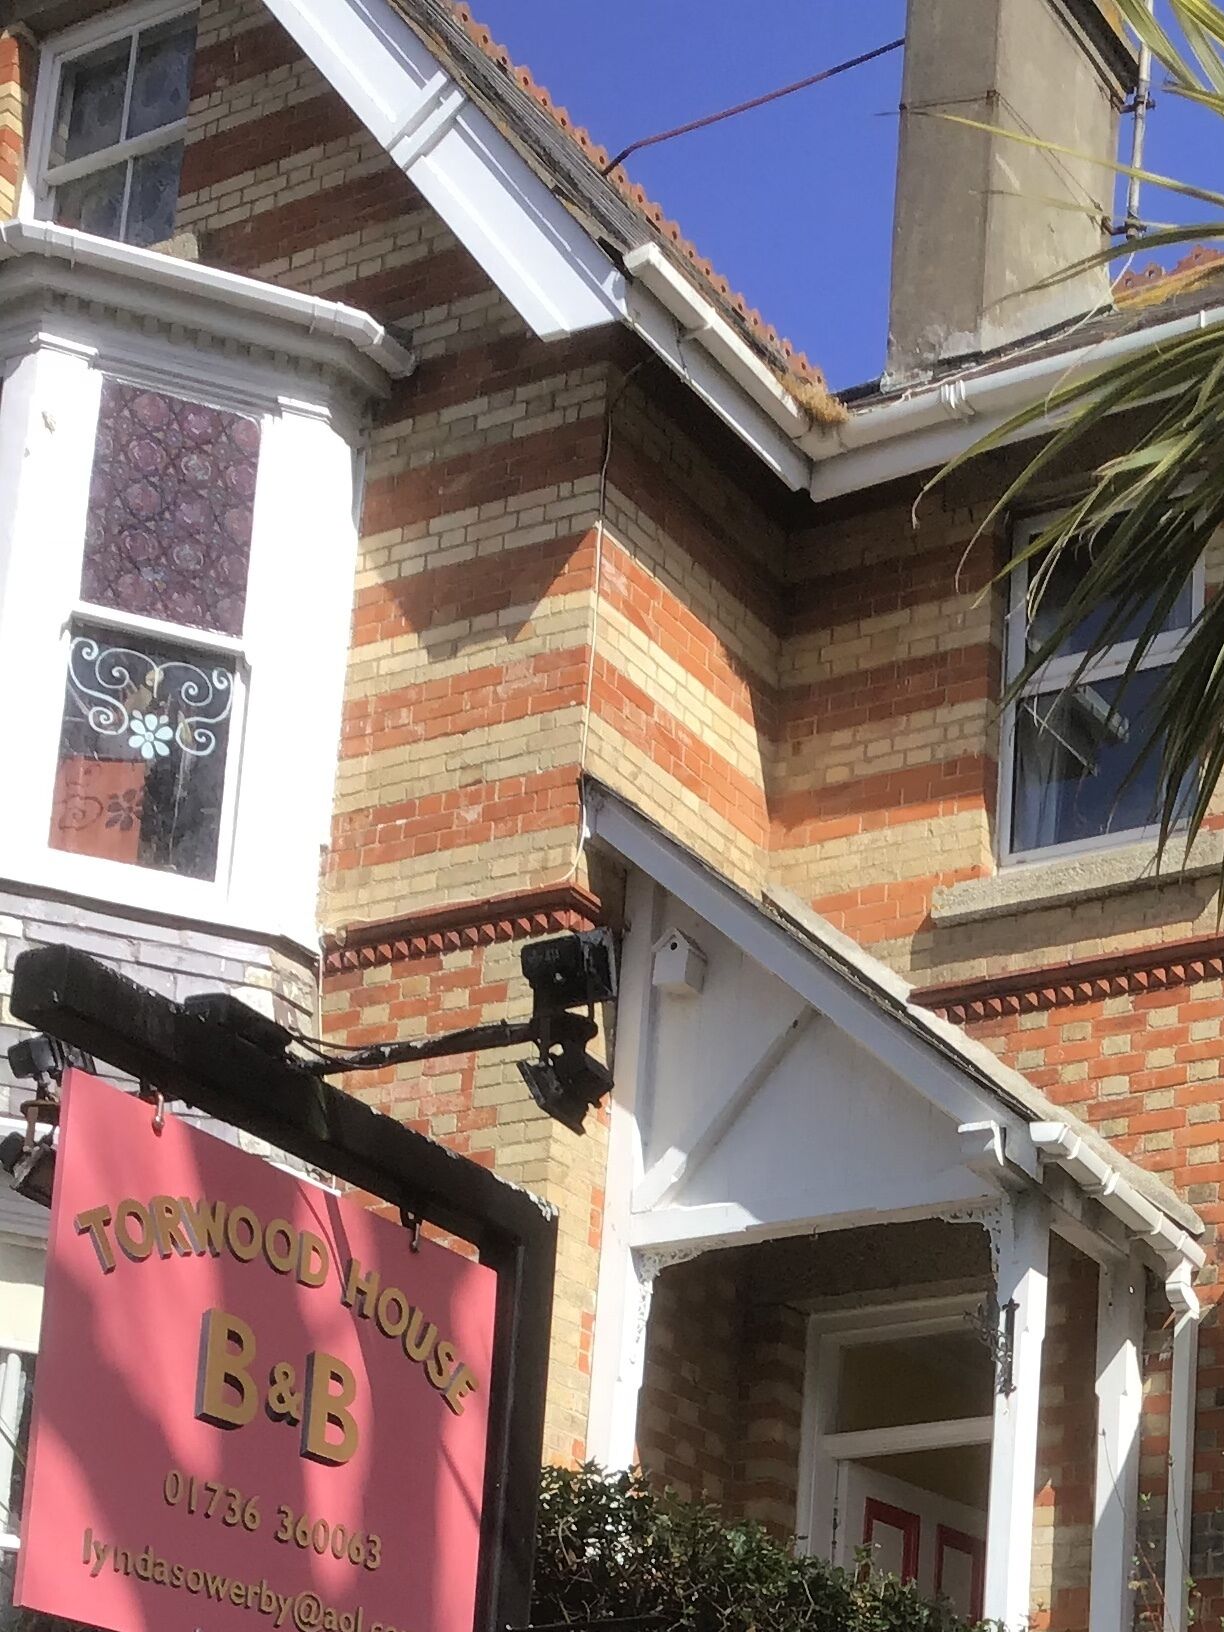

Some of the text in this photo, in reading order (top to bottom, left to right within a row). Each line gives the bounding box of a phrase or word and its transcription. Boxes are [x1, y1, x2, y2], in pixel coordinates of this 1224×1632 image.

[74, 1195, 480, 1415] TORWOOD HOUSE
[164, 1472, 383, 1570] 01736 360063
